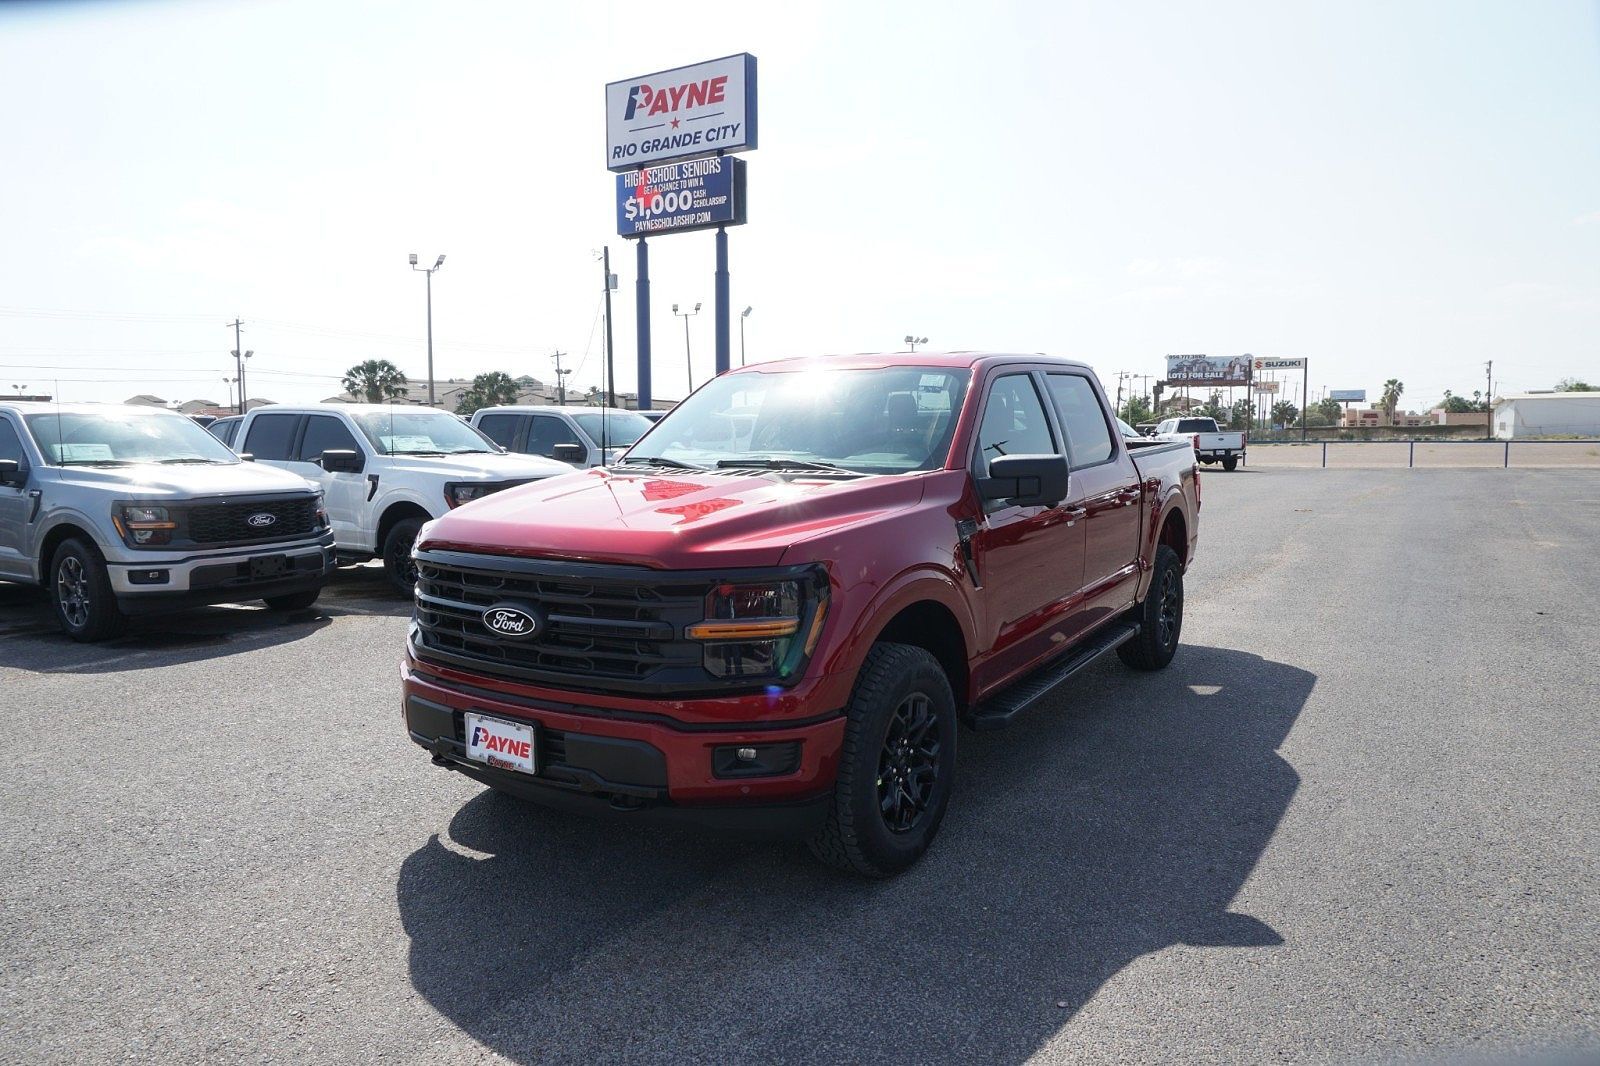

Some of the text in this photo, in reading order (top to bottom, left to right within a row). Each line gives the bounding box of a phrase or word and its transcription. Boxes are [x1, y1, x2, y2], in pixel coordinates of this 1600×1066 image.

[624, 75, 729, 121] PAYNE
[612, 123, 741, 160] RIO GRANDE CITY
[624, 159, 721, 188] HIGH SCHOOL SENIORS
[643, 177, 704, 195] GET A CHANCE TO WIN A
[693, 189, 707, 198] CASH
[624, 190, 693, 221] $1,000
[693, 195, 727, 209] SCHOLARSHIP
[635, 211, 711, 232] PAYNESCHOLARSHIP.COM
[1265, 360, 1301, 368] SUZUKI
[492, 611, 525, 632] Ford
[471, 726, 531, 759] PAYNE
